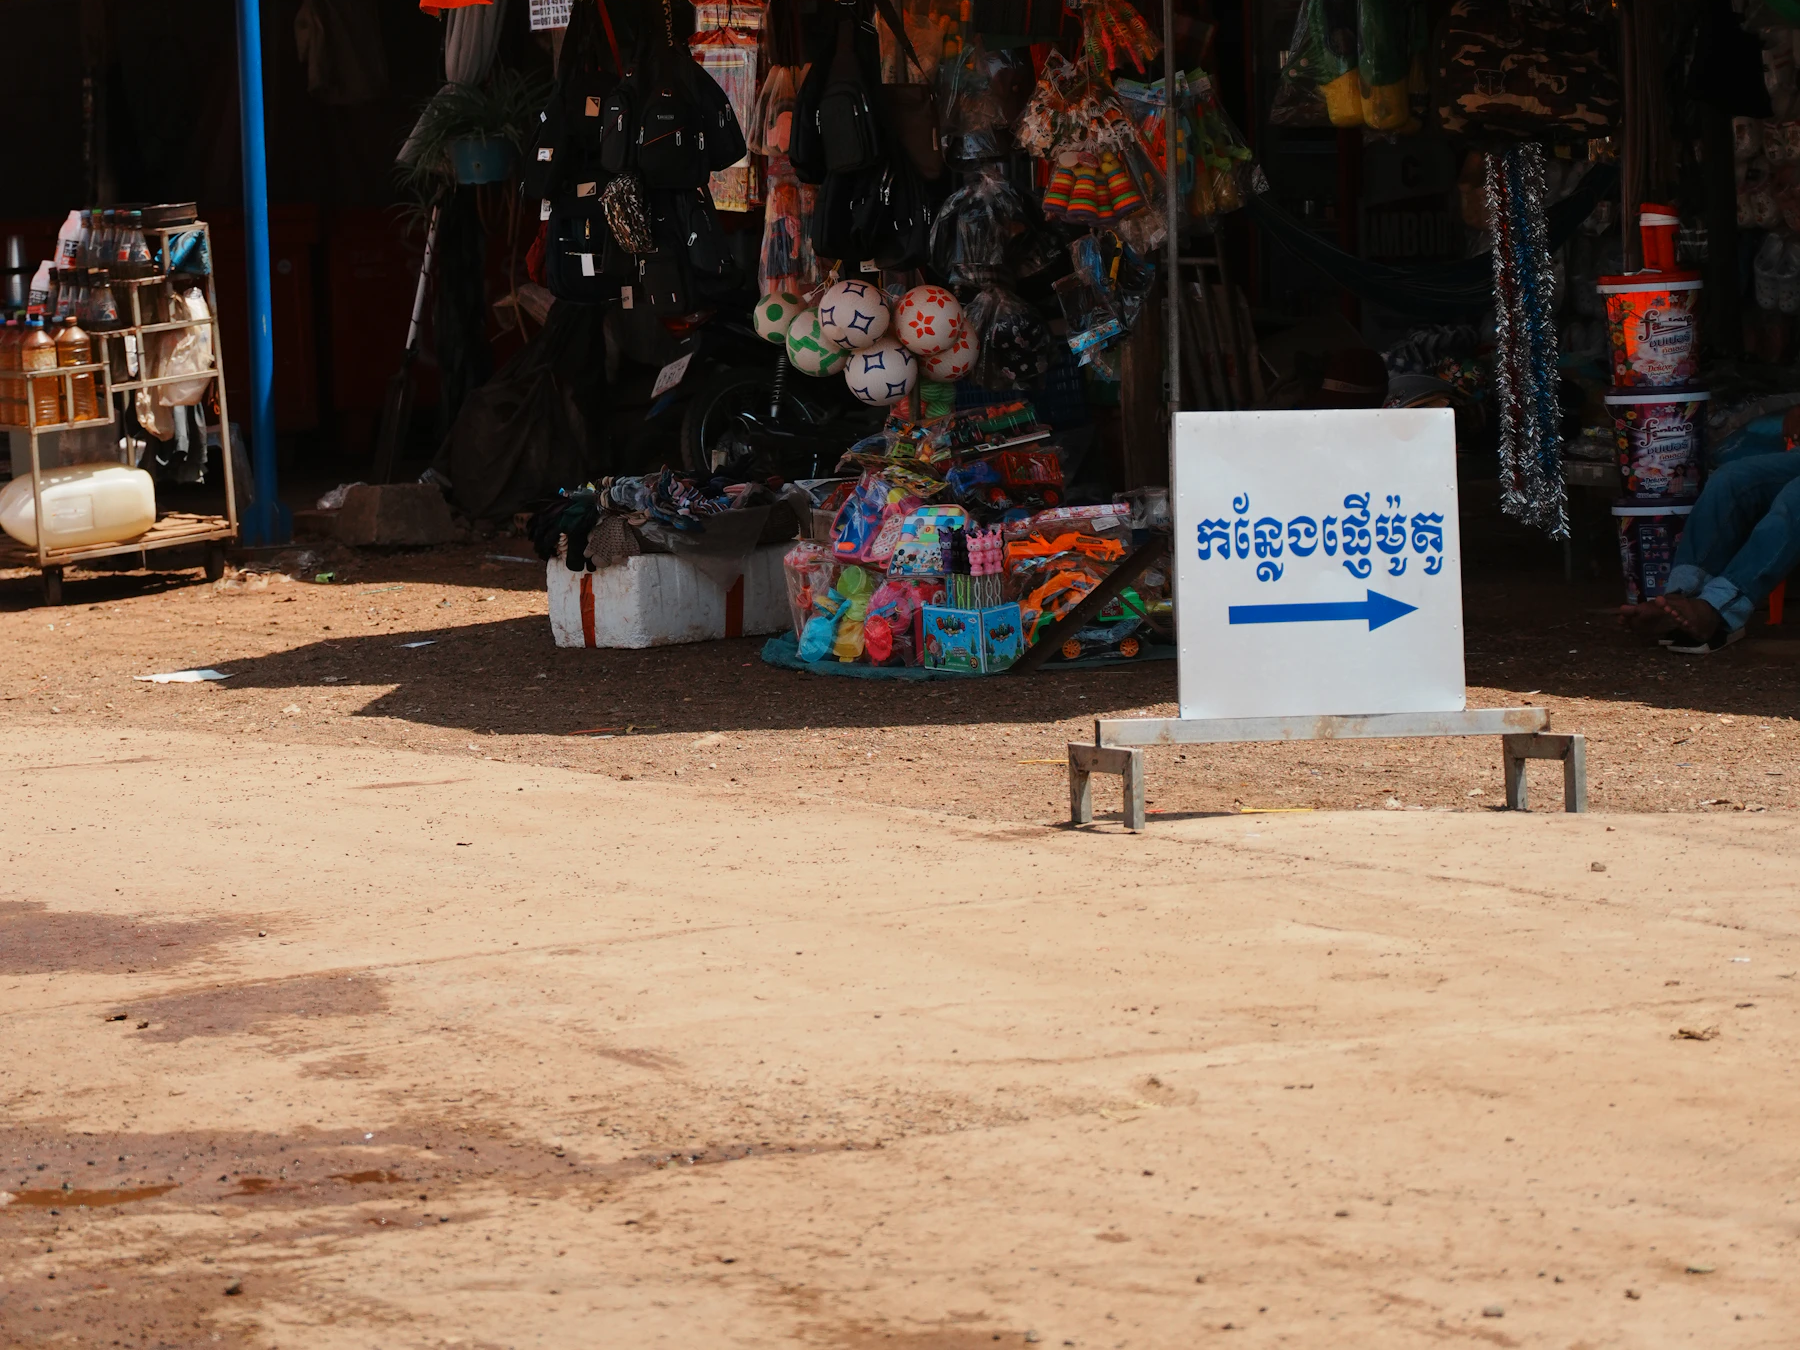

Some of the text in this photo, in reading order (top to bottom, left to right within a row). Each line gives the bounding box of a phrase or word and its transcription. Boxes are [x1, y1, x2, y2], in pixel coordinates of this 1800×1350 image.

[1197, 492, 1444, 582] កន្លែងផ្ញើម៉ូតូ
